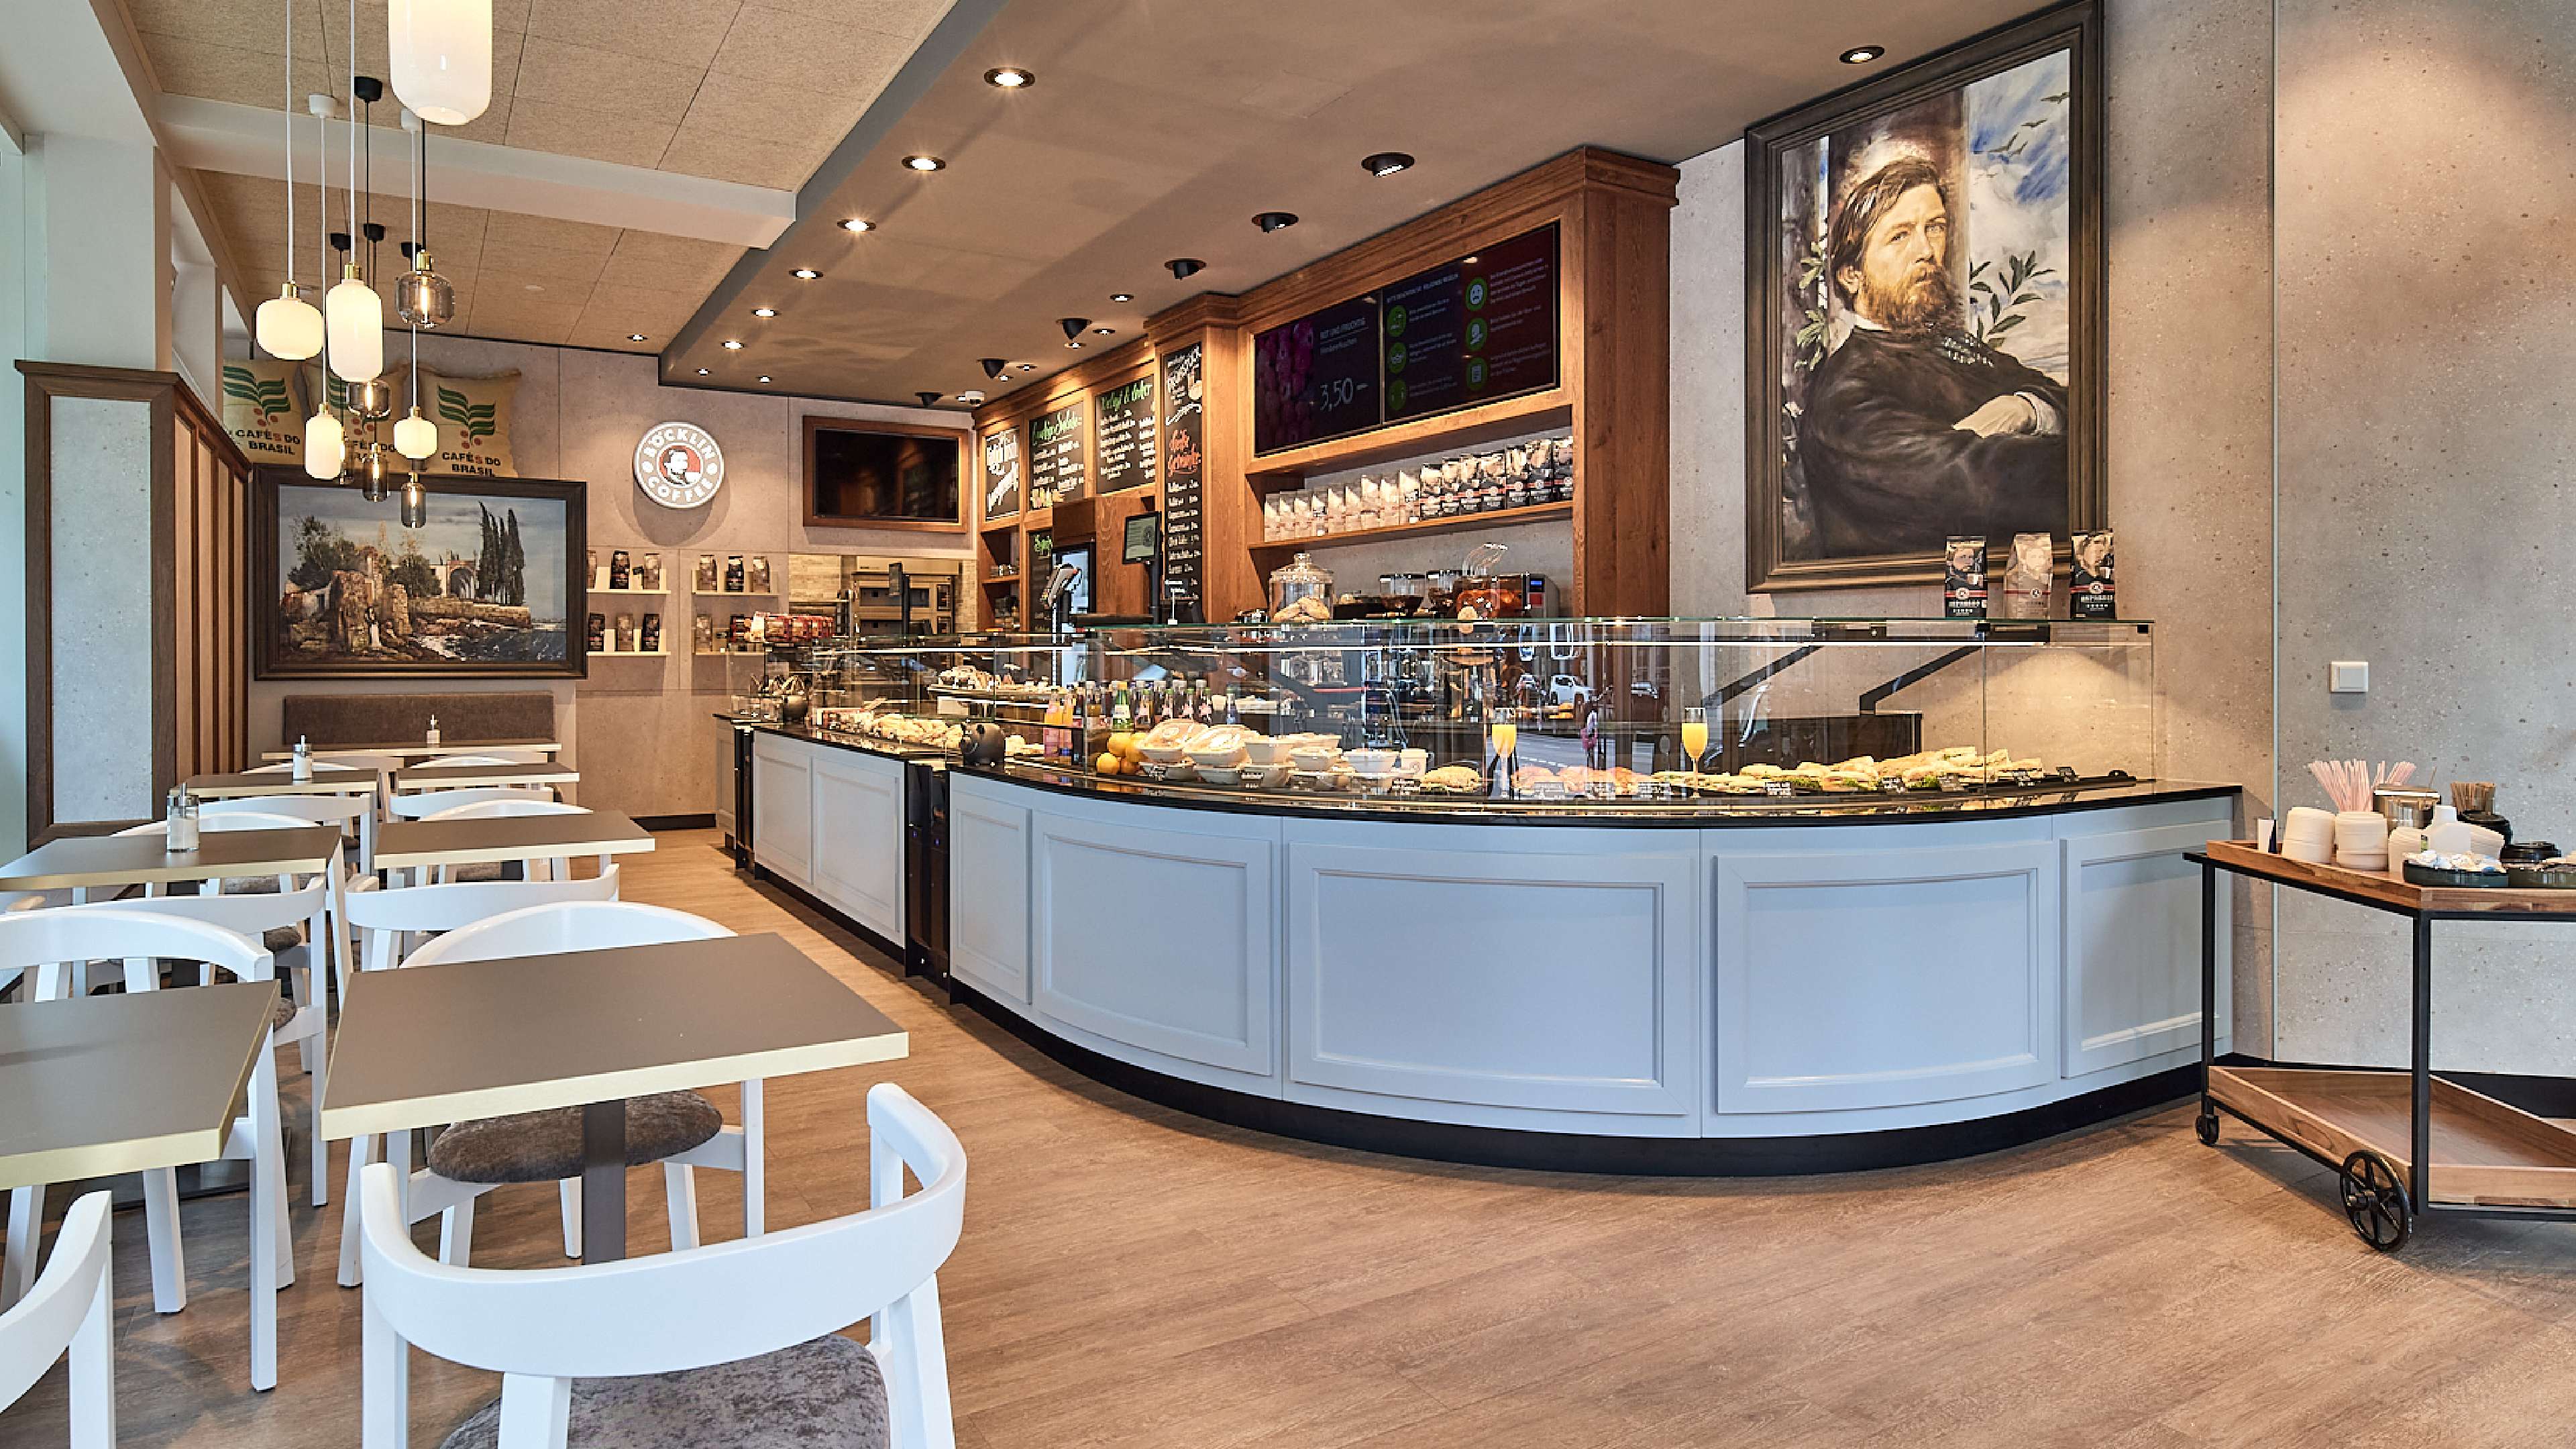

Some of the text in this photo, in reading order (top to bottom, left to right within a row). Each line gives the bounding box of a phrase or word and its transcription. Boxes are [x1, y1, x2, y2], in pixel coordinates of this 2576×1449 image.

[284, 434, 301, 444] DO
[248, 440, 295, 455] BRASIL
[485, 456, 502, 466] DO
[451, 464, 496, 478] BRASIL
[648, 476, 713, 502] COFFEE
